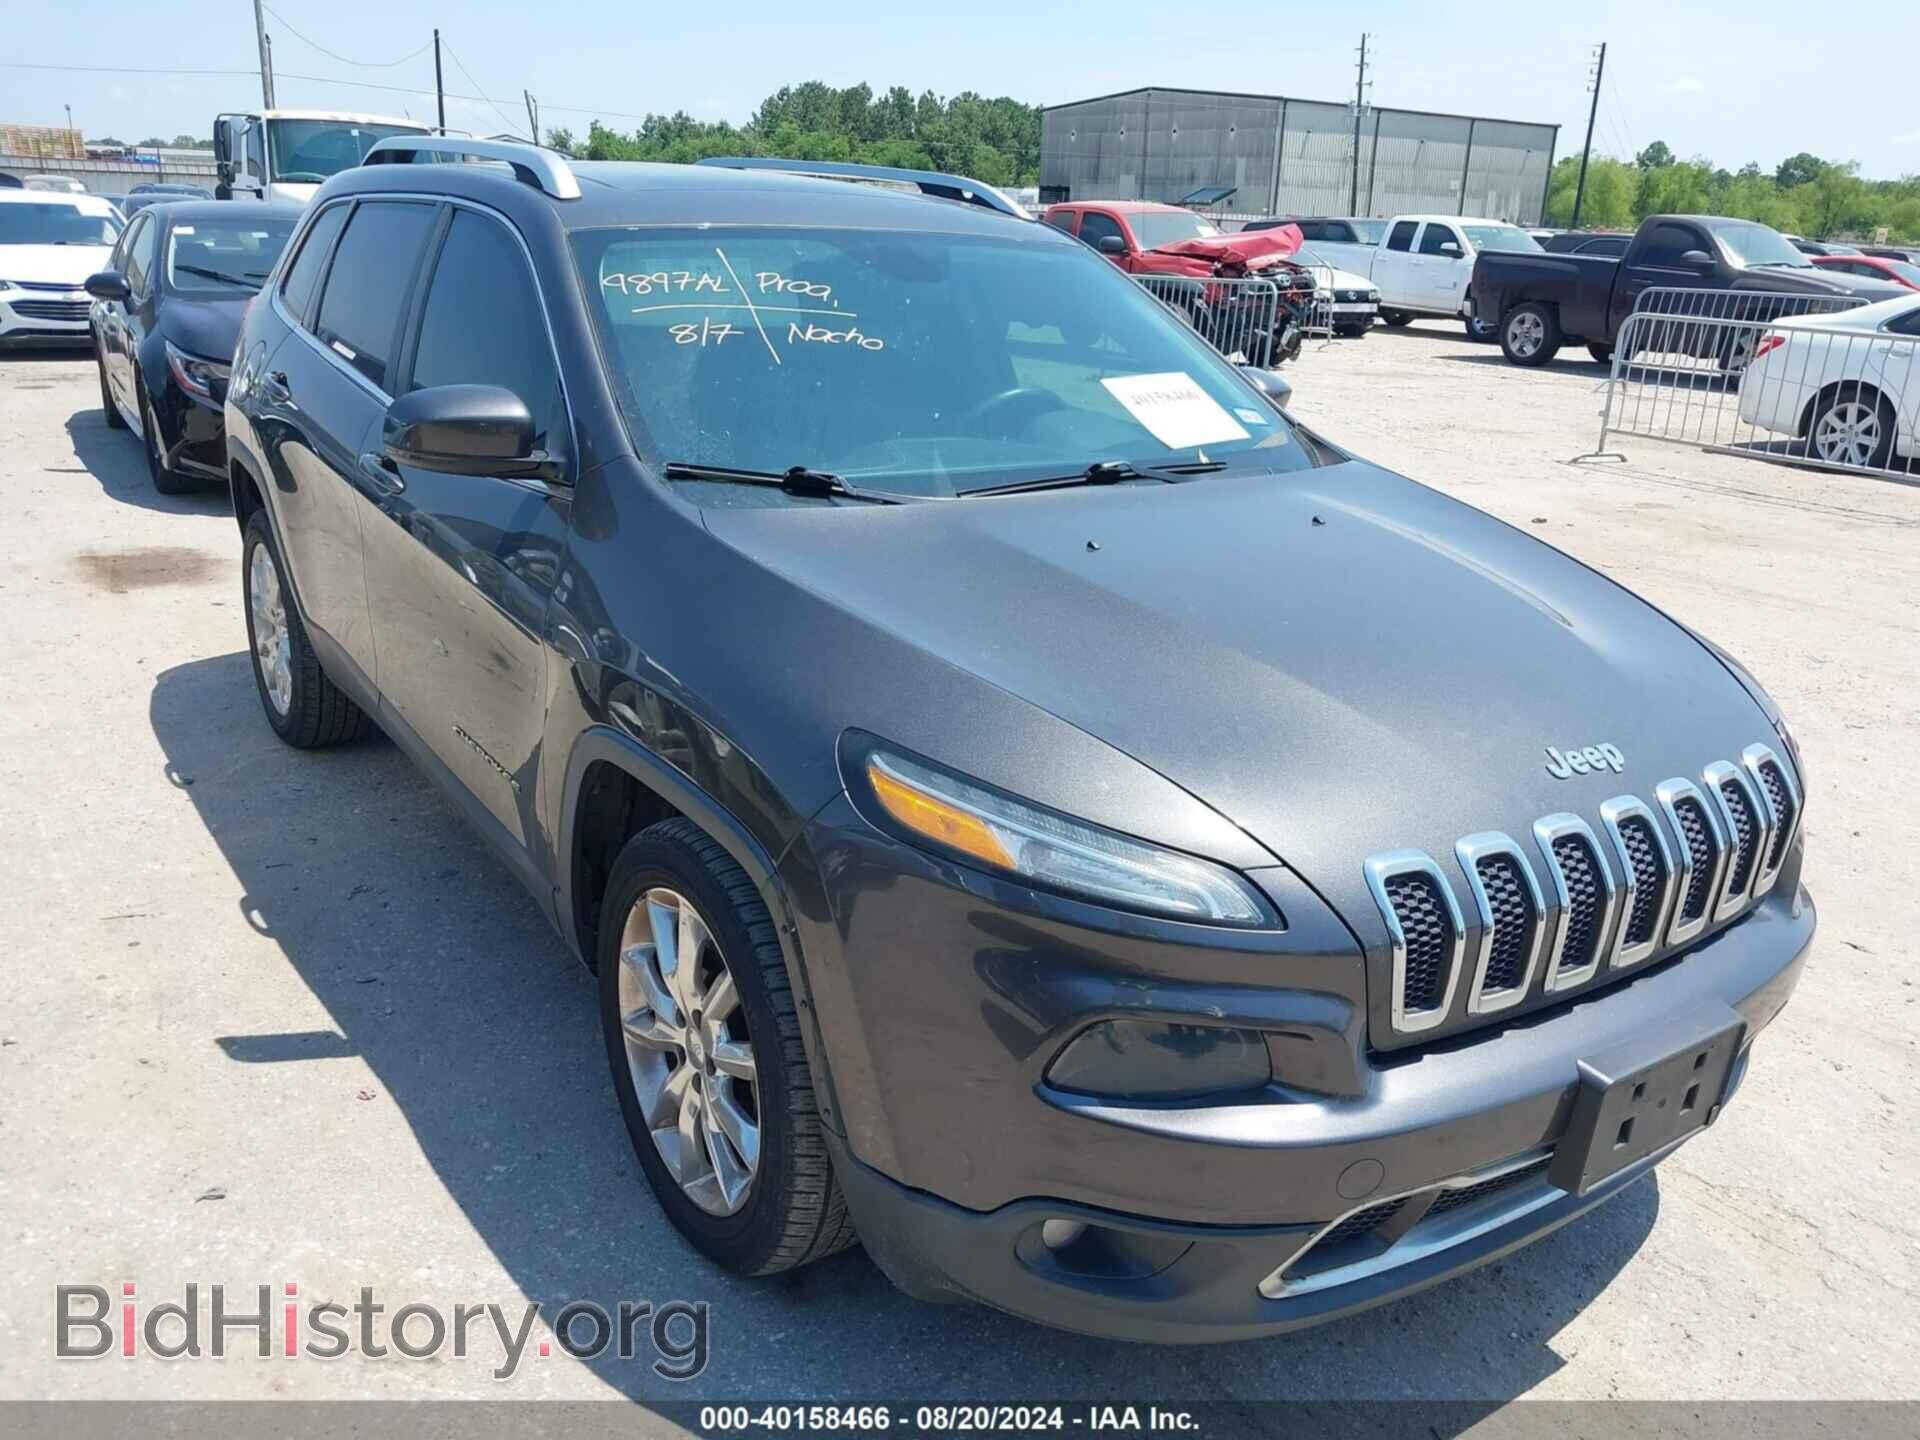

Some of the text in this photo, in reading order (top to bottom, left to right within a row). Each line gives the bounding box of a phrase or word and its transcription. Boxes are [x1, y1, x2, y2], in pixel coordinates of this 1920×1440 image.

[668, 316, 745, 347] 8/7
[788, 322, 885, 350] Nacho
[1545, 742, 1625, 780] Jeep
